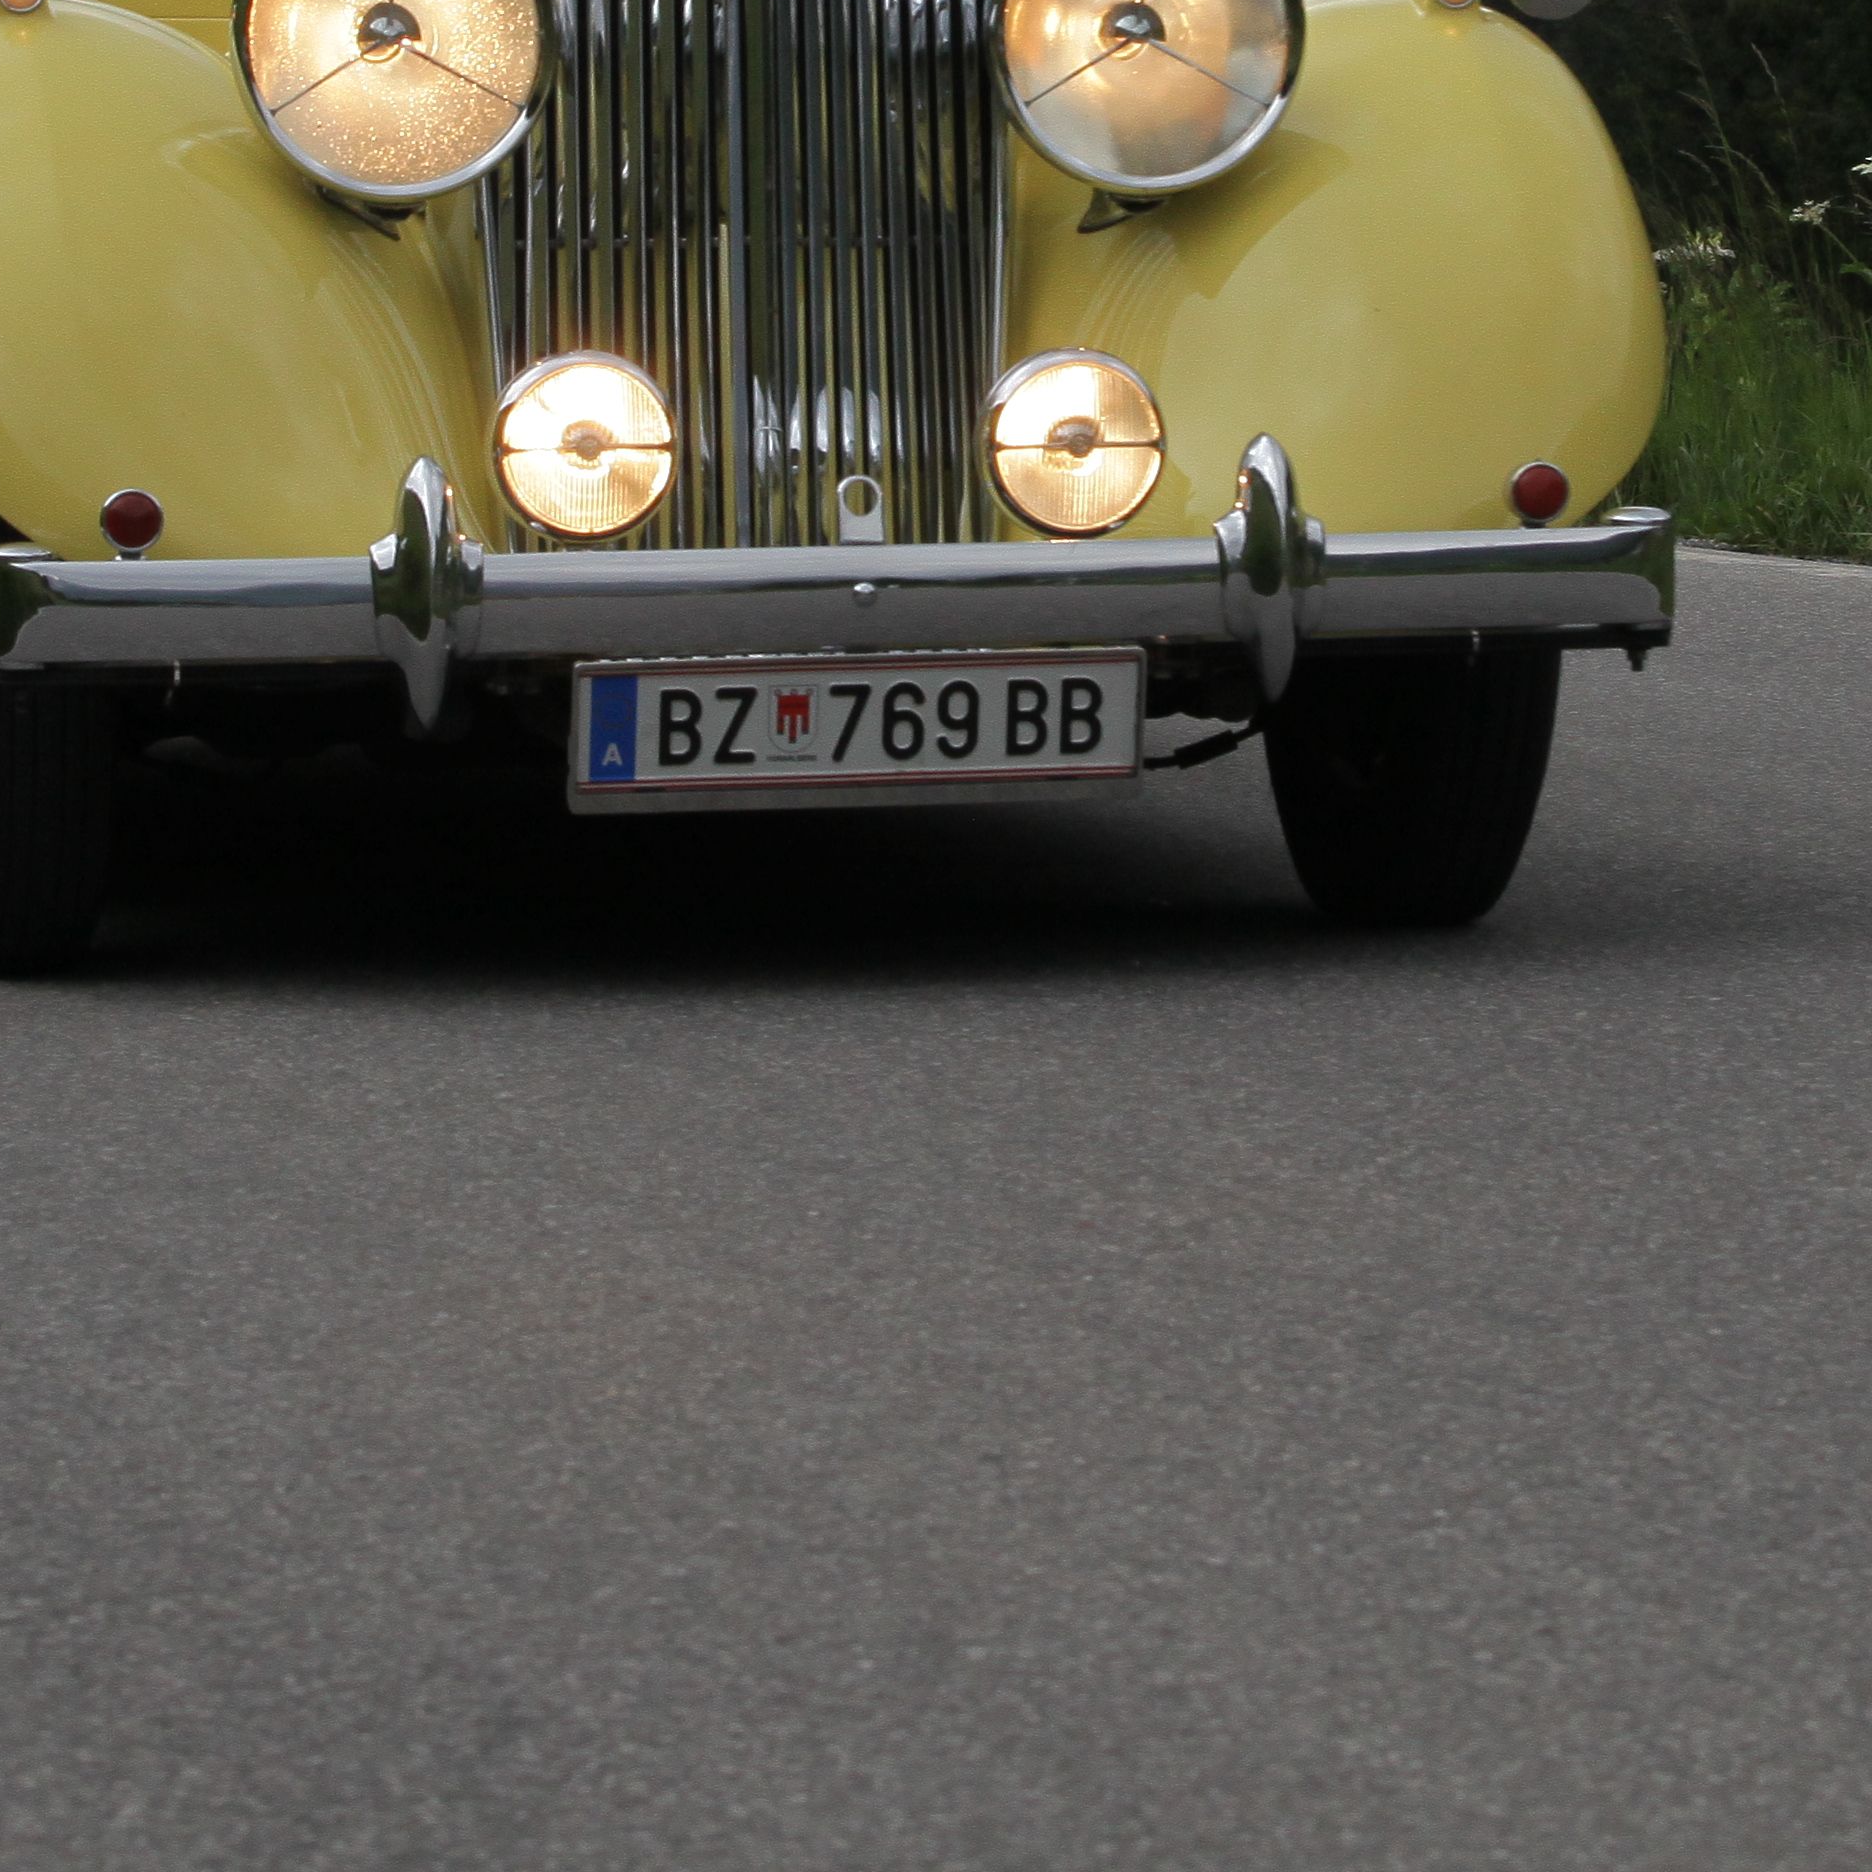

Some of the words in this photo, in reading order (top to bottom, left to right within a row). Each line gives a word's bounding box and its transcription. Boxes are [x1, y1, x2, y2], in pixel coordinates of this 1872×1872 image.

[658, 685, 759, 766] BZ
[828, 679, 981, 763] 769
[1005, 676, 1104, 758] BB
[601, 742, 624, 767] A
